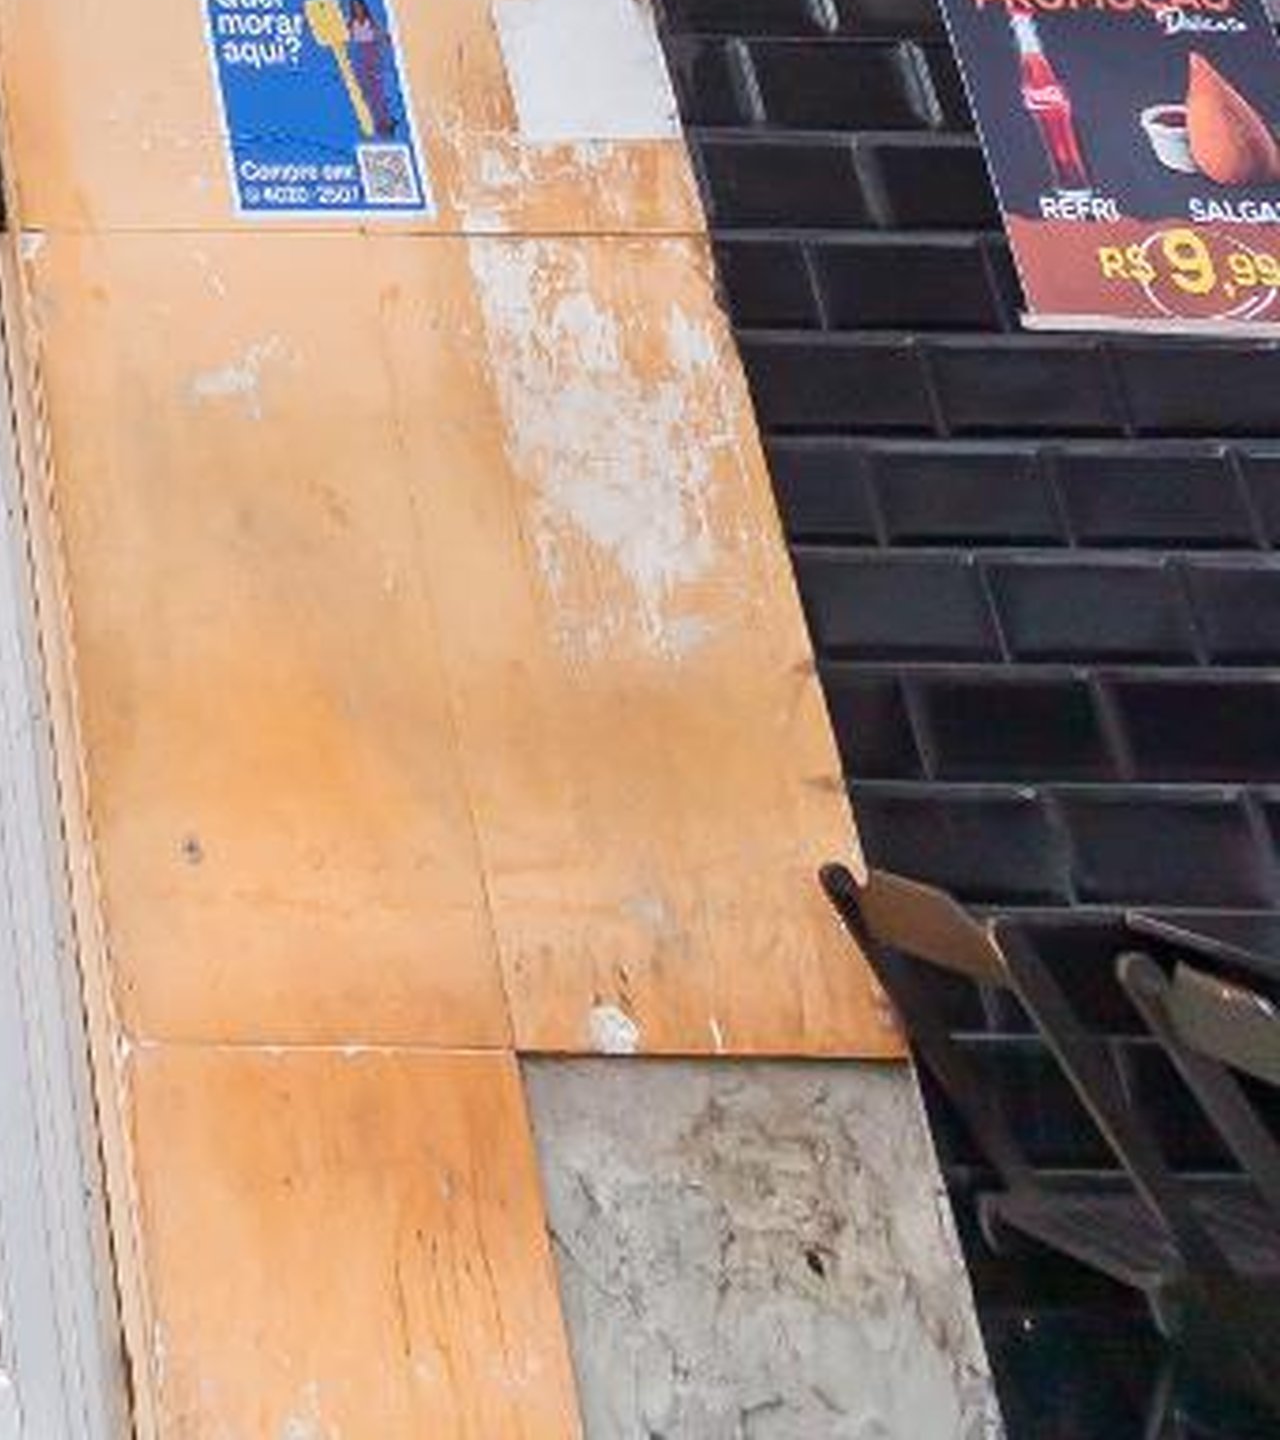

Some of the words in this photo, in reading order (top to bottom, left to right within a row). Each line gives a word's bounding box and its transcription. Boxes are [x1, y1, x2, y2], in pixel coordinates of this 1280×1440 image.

[218, 13, 304, 36] morar
[223, 38, 302, 69] aqui?
[1040, 197, 1120, 222] REFRI
[1189, 198, 1280, 223] SALGA
